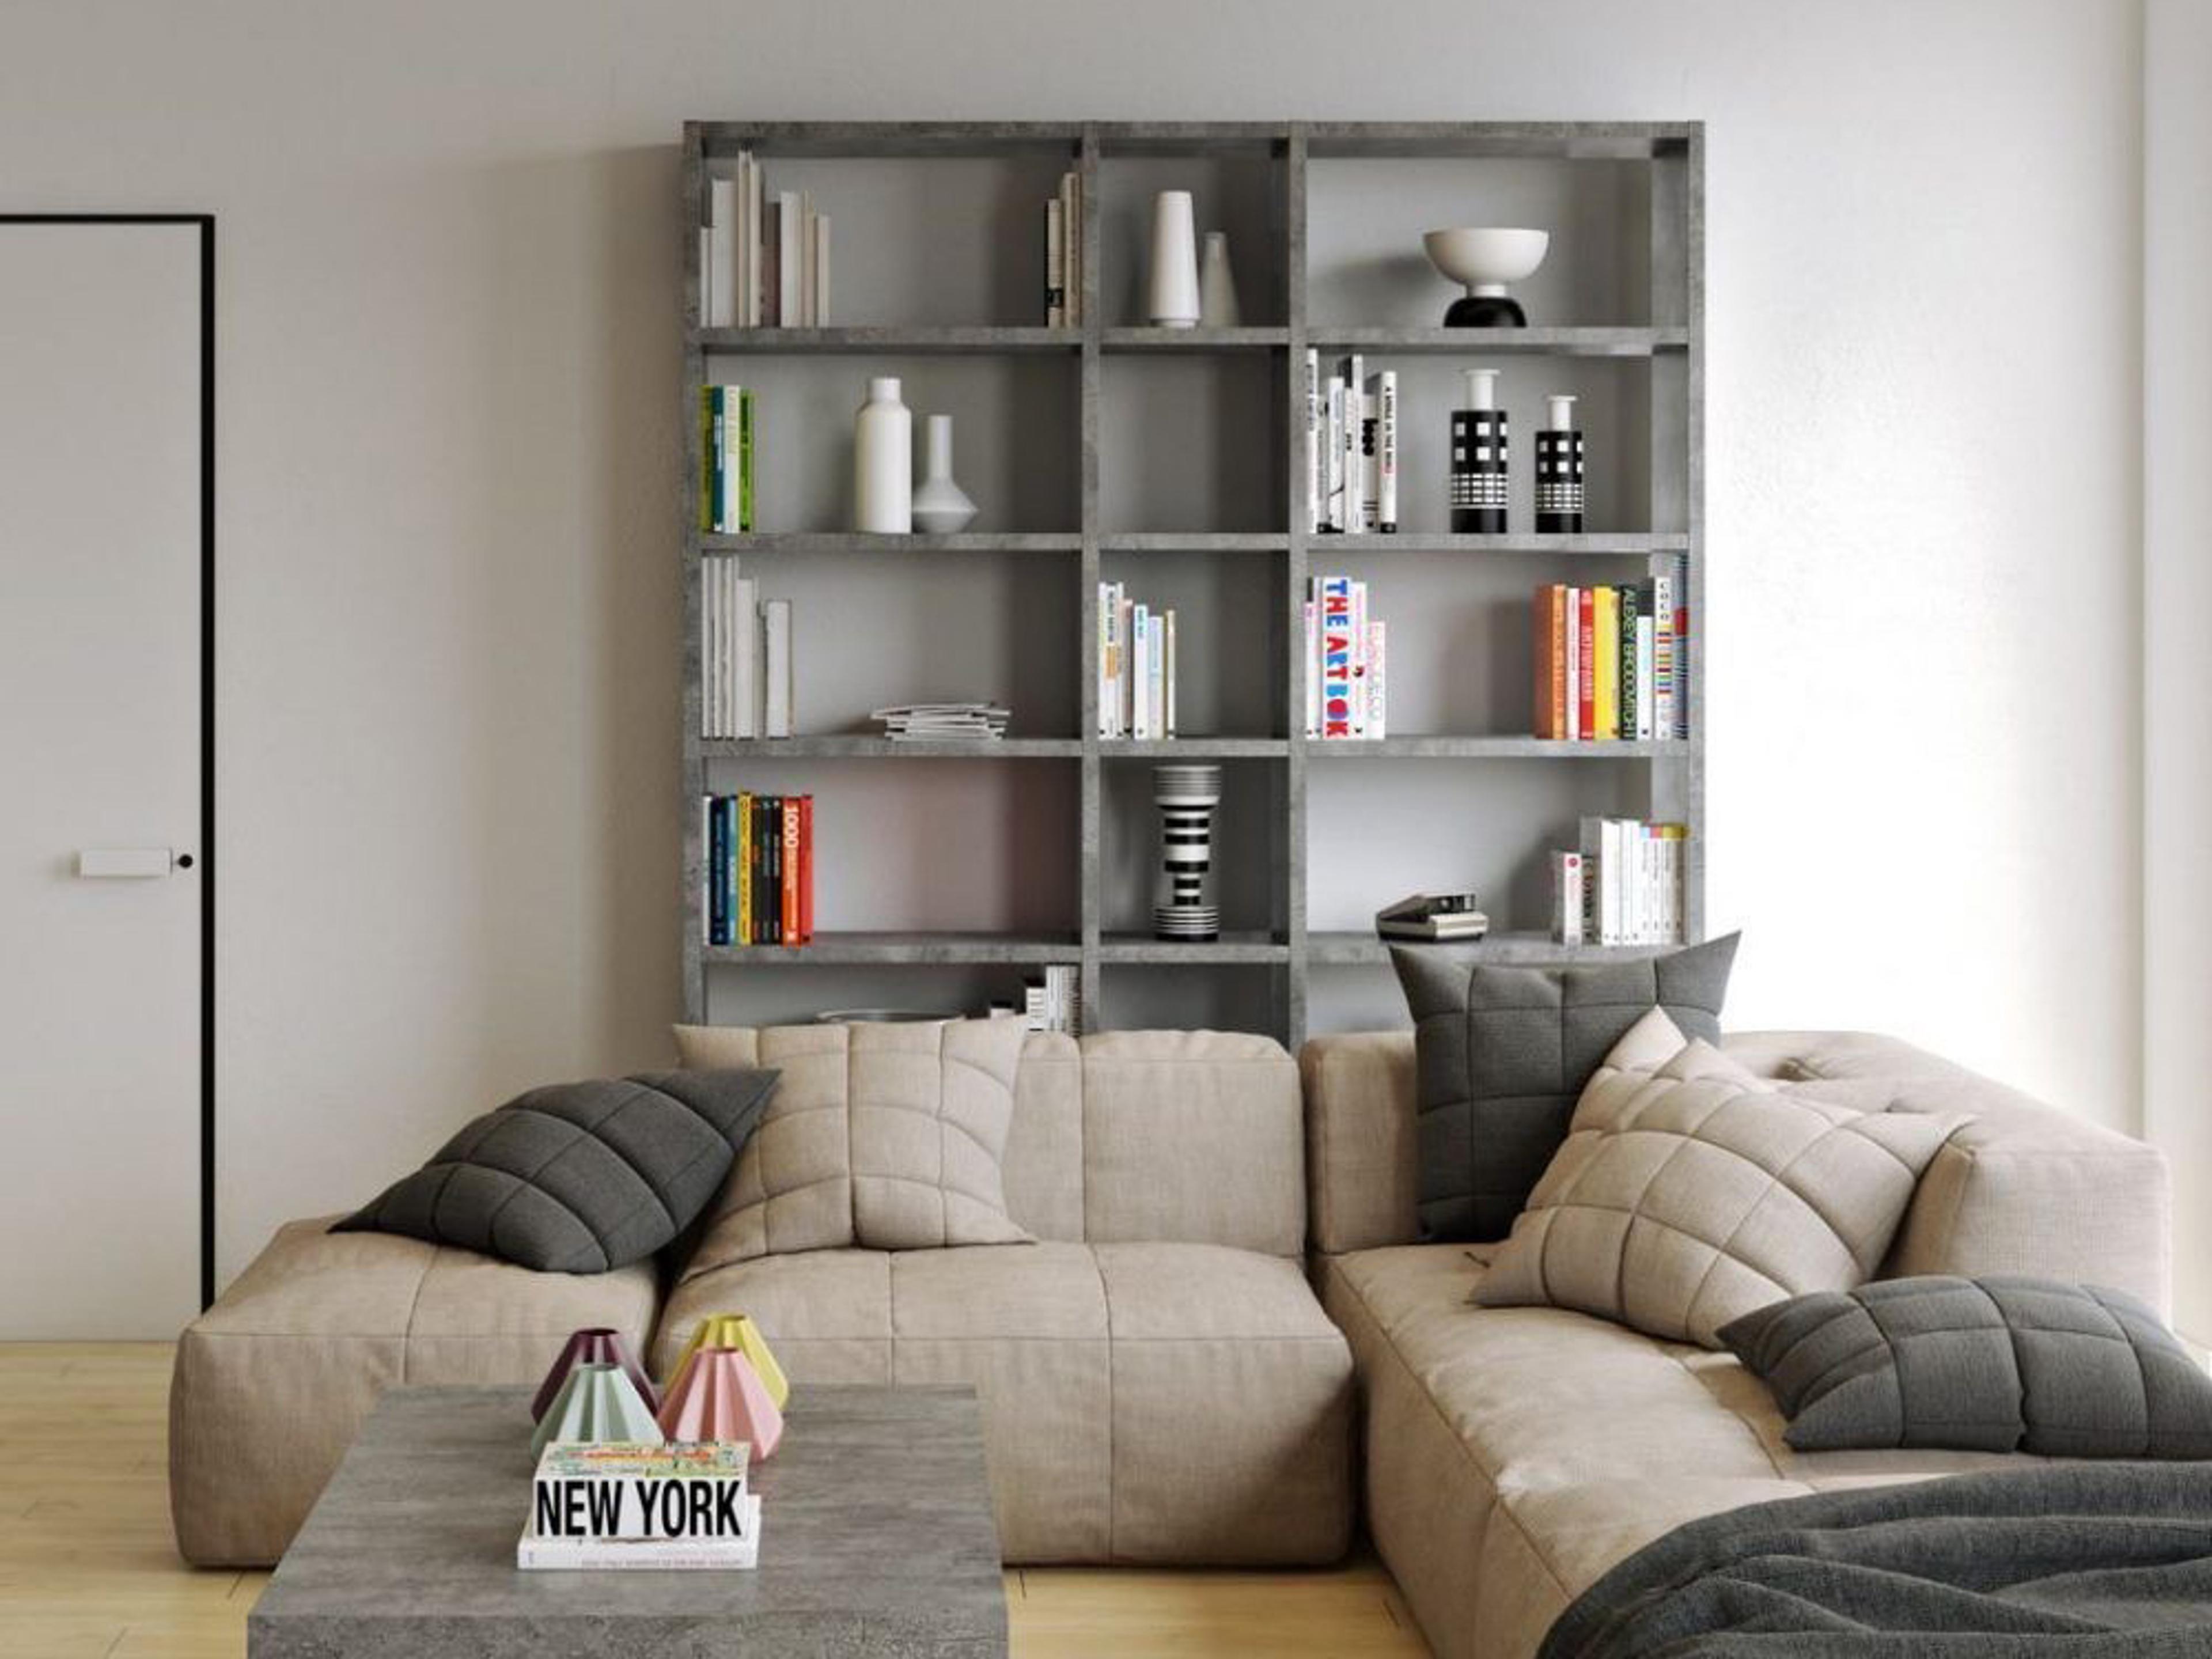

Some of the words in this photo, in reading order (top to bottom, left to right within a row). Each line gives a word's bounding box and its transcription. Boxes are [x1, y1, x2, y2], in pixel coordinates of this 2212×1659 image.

[1327, 579, 1347, 626] THE
[1623, 588, 1637, 639] ALEXEY
[1327, 637, 1347, 680] ART
[783, 805, 800, 848] 1000
[536, 1480, 623, 1536] NEW
[636, 1479, 741, 1537] YORK
